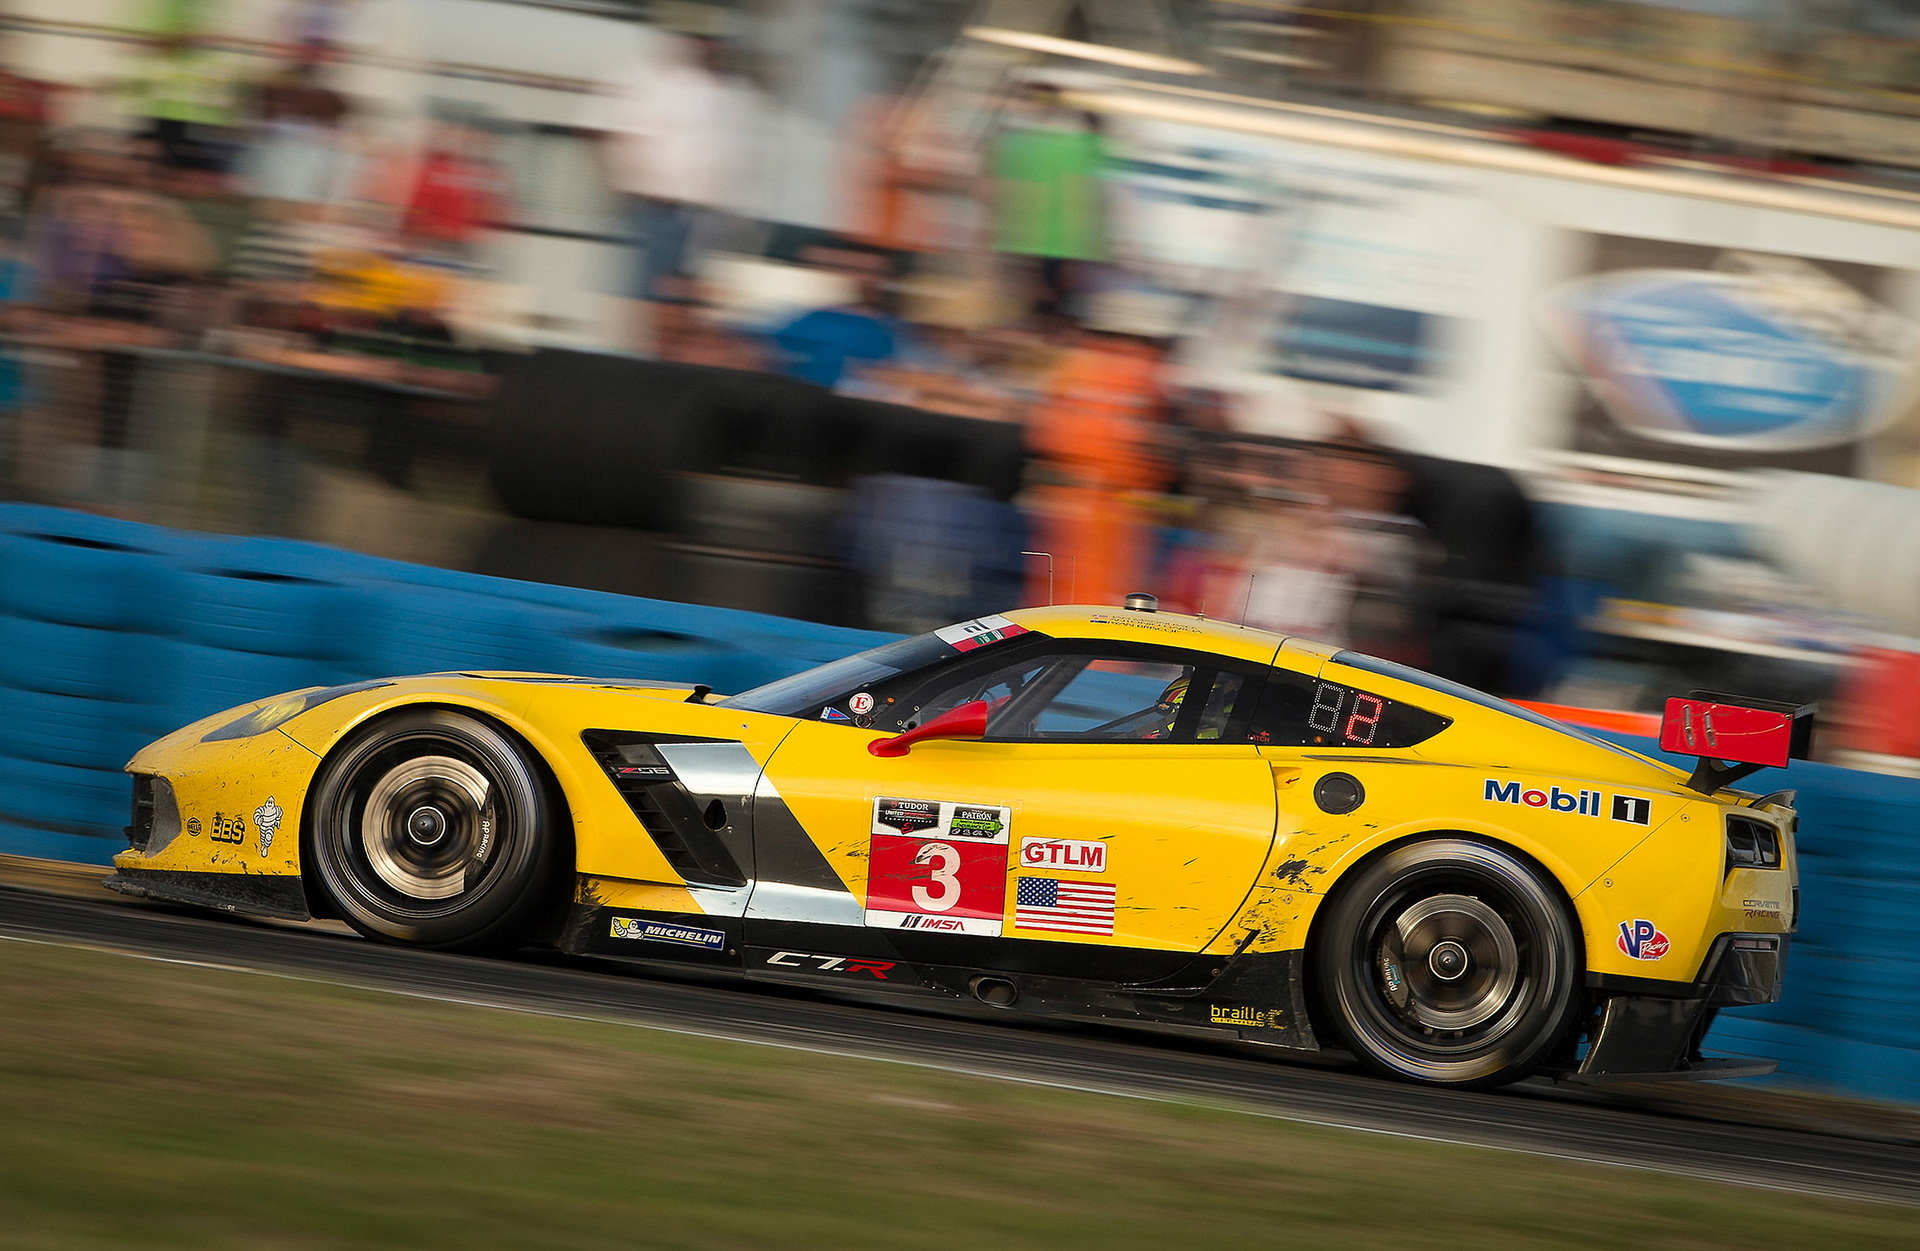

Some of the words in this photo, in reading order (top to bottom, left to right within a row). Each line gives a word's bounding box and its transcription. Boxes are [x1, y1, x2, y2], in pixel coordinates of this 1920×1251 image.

[854, 697, 868, 710] E
[898, 802, 930, 811] TUDOR
[1484, 780, 1600, 817] Mobil
[210, 817, 245, 845] BBS
[1025, 842, 1103, 867] GTLM
[912, 843, 961, 911] 3
[645, 925, 722, 944] MICHELIN
[921, 918, 965, 931] IMSA
[1619, 919, 1655, 959] VP
[767, 951, 896, 979] C7.R
[1211, 1004, 1265, 1020] braille
